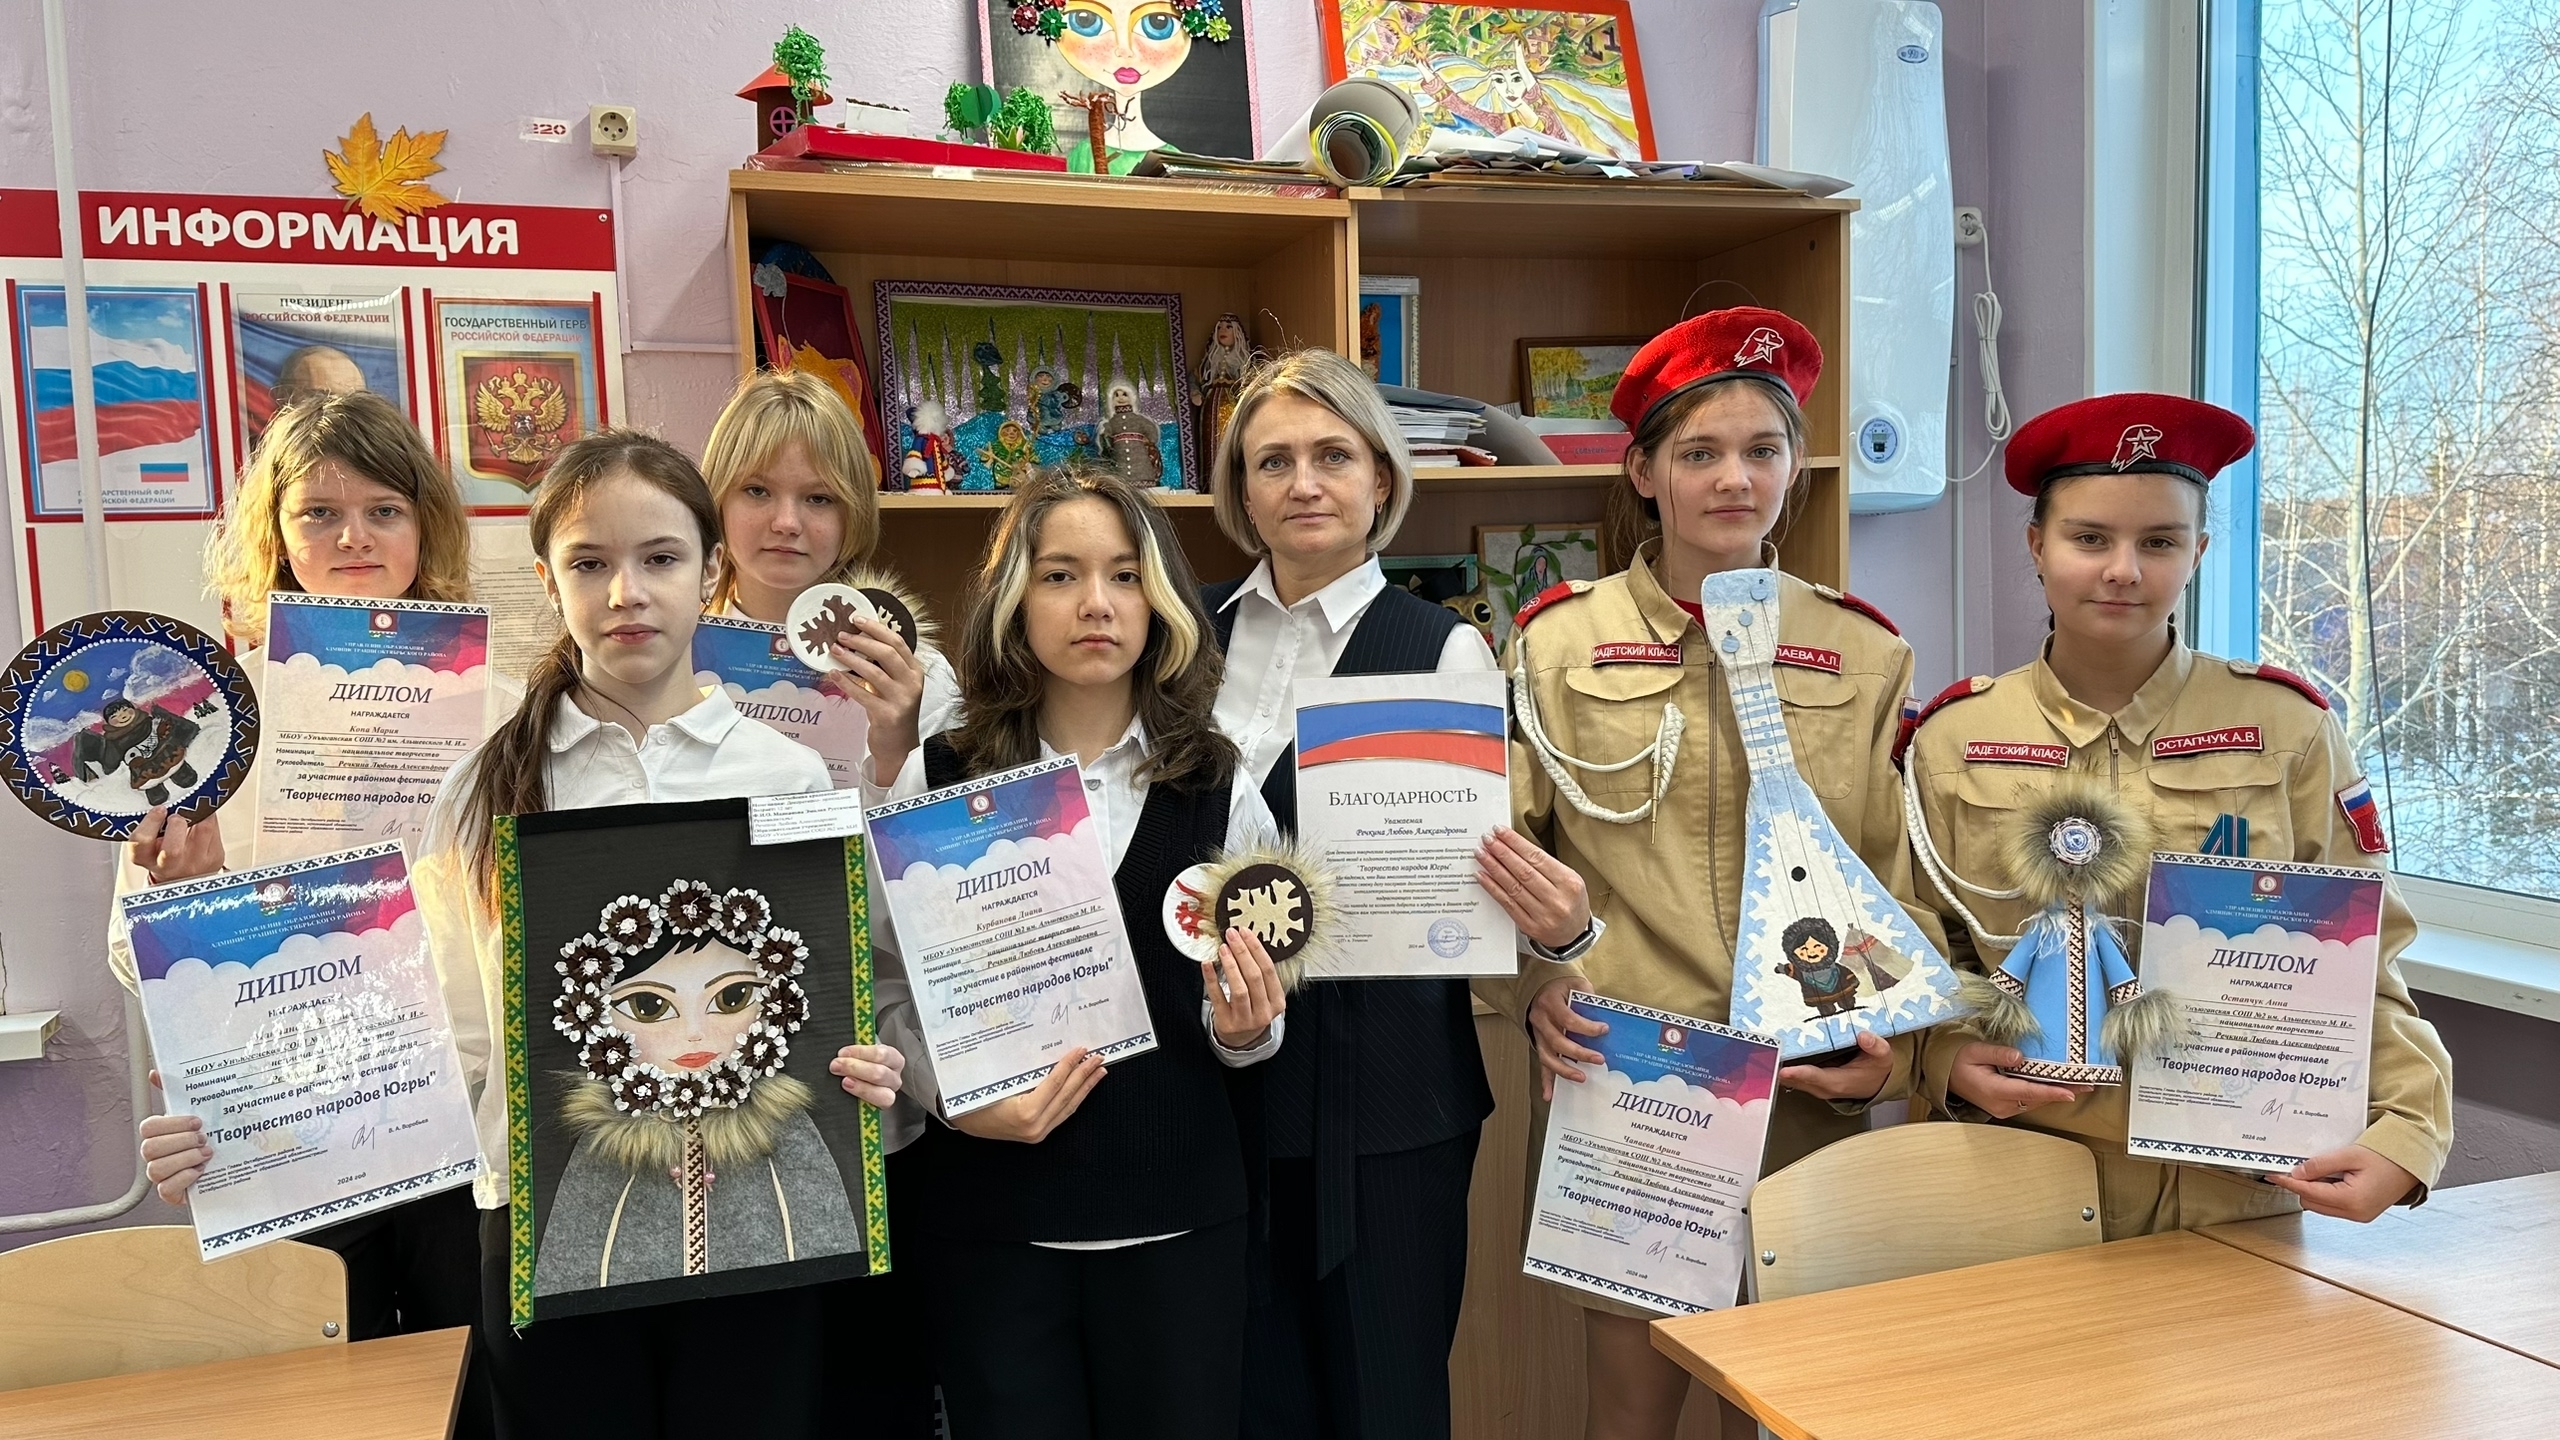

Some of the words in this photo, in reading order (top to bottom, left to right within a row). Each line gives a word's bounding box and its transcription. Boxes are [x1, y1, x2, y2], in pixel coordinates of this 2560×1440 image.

[98, 205, 519, 262] ИНФОРМАЦИЯ
[244, 312, 322, 323] РОССИЙСКОЙ
[323, 313, 390, 323] ФЕДЕРАЦИИ
[444, 317, 557, 329] ГОСУДАРСТВЕННЫЙ
[560, 319, 587, 330] ГЕРБ
[451, 330, 520, 342] РОССИЙСКОЙ
[522, 332, 583, 343] ФЕДЕРАЦИИ
[1593, 645, 1646, 659] КАДЕТСКИЙ
[1648, 646, 1678, 658] КЛАСС
[1817, 653, 1839, 667] А.Л.
[329, 682, 432, 707] ДИПЛОМ
[351, 709, 409, 719] НАГРАЖДАЕТСЯ
[278, 731, 301, 740] МБОУ
[354, 735, 374, 743] СОШ
[349, 725, 370, 733] Копа
[371, 726, 399, 736] Мария
[2156, 735, 2230, 751] ОСТАПЧУК
[2232, 731, 2259, 744] А.В.
[275, 747, 314, 755] Номинация
[341, 747, 393, 757] национальное
[395, 750, 439, 759] творчество
[276, 758, 324, 768] Руководитель
[338, 760, 368, 768] Речкина
[370, 761, 398, 769] Любовь
[1967, 745, 2029, 757] КАДЕТСКИЙ
[2031, 747, 2066, 761] КЛАСС
[307, 772, 345, 784] участие
[353, 774, 396, 785] районном
[279, 786, 361, 805] "Творчество
[363, 790, 414, 807] народов
[1328, 788, 1477, 808] БЛАГОДАРНОСТЬ
[1356, 828, 1385, 836] Речкина
[1386, 827, 1413, 835] Любовь
[1414, 826, 1467, 836] Александровна
[1357, 864, 1399, 872] "Творчество
[953, 858, 1053, 902] ДИПЛОМ
[981, 890, 1038, 912] НАГРАЖДАЕТСЯ
[975, 913, 1016, 931] Курбанова
[1017, 906, 1042, 919] Диана
[922, 950, 944, 961] МБОУ
[994, 930, 1013, 940] СОШ
[923, 958, 961, 974] Номинация
[1038, 924, 1080, 942] творчество
[928, 967, 974, 987] Руководитель
[987, 954, 1016, 967] Речкина
[1018, 946, 1044, 958] Любовь
[1044, 930, 1098, 950] Александровна
[2207, 948, 2317, 978] ДИПЛОМ
[231, 953, 364, 1006] ДИПЛОМ
[952, 985, 962, 994] за
[963, 975, 1000, 993] участие
[1006, 960, 1047, 979] районном
[1047, 945, 1093, 966] фестивале
[942, 987, 1020, 1021] "Творчество
[1021, 971, 1071, 997] народов
[1072, 957, 1114, 980] Югры"
[2229, 978, 2292, 991] НАГРАЖДАЕТСЯ
[2220, 993, 2263, 1006] Остапчук
[2265, 998, 2287, 1007] Анна
[2232, 1009, 2252, 1018] СОШ
[2219, 1019, 2274, 1031] национальное
[2275, 1025, 2323, 1036] творчество
[1040, 1042, 1053, 1050] 2024
[2215, 1031, 2247, 1042] Речкина
[2249, 1034, 2279, 1045] Любовь
[2280, 1038, 2340, 1051] Александровна
[2184, 1042, 2223, 1054] участие
[2224, 1046, 2229, 1054] в
[2231, 1046, 2276, 1060] районном
[2277, 1051, 2329, 1065] фестивале
[184, 1062, 215, 1077] МБОУ
[2154, 1056, 2239, 1078] "Творчество
[2241, 1065, 2296, 1084] народов
[2298, 1072, 2346, 1089] Югры"
[185, 1071, 237, 1092] Номинация
[190, 1082, 253, 1106] Руководитель
[222, 1105, 235, 1114] за
[236, 1091, 286, 1112] участие
[207, 1106, 313, 1147] "Творчество
[314, 1086, 381, 1117] народов
[383, 1071, 437, 1097] Югры"
[1613, 1089, 1711, 1132] ДИПЛОМ
[1631, 1121, 1687, 1142] НАГРАЖДАЕТСЯ
[1561, 1132, 1584, 1144] МБОУ
[1630, 1151, 1649, 1161] СОШ
[1623, 1135, 1654, 1150] Чапаева
[1656, 1144, 1680, 1157] Арина
[1558, 1143, 1593, 1158] Номинация
[1668, 1171, 1711, 1188] творчество
[337, 1174, 354, 1186] 2024
[355, 1171, 367, 1182] год
[1557, 1155, 1601, 1172] Руководитель
[1613, 1170, 1642, 1183] Речкина
[1643, 1178, 1670, 1191] Любовь
[1670, 1185, 1725, 1206] Александровна
[1574, 1173, 1584, 1181] за
[1584, 1176, 1619, 1192] участие
[1626, 1186, 1667, 1205] районном
[1667, 1197, 1713, 1217] фестивале
[1556, 1184, 1631, 1216] "Творчество
[1633, 1205, 1682, 1230] народов
[1684, 1220, 1726, 1242] Югры"
